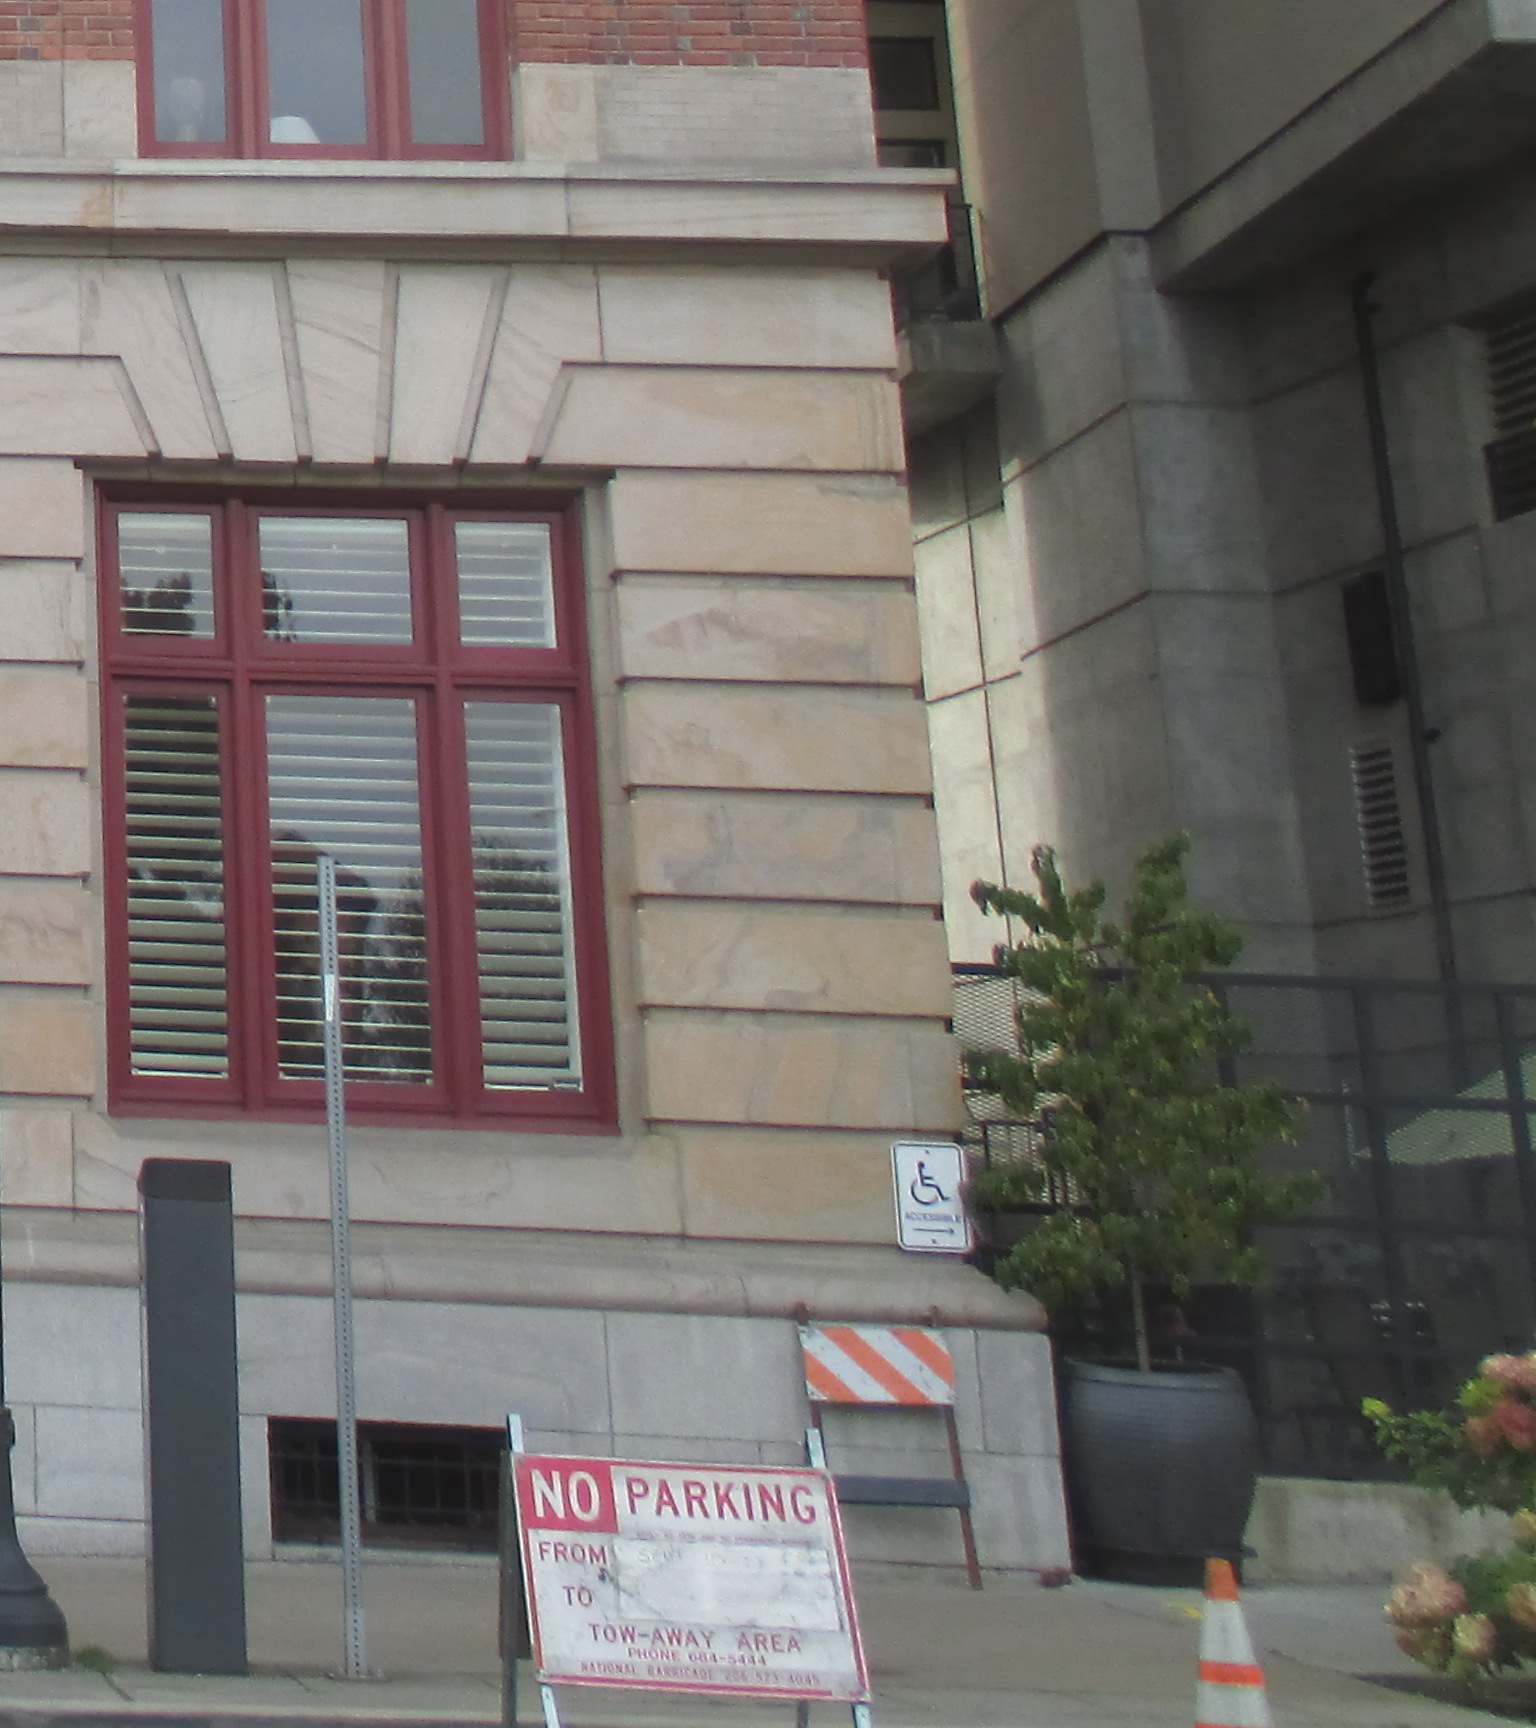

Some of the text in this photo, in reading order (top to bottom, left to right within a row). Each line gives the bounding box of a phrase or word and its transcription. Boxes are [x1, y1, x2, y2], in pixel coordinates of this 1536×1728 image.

[530, 1469, 817, 1524] NO PARKING
[538, 1541, 607, 1565] FROM
[562, 1585, 594, 1607] TO
[588, 1623, 803, 1653] TOW-AWAY AREA
[628, 1647, 680, 1662] PHONE
[580, 1661, 636, 1674] NATIONAL
[647, 1665, 713, 1680] BARRICADE
